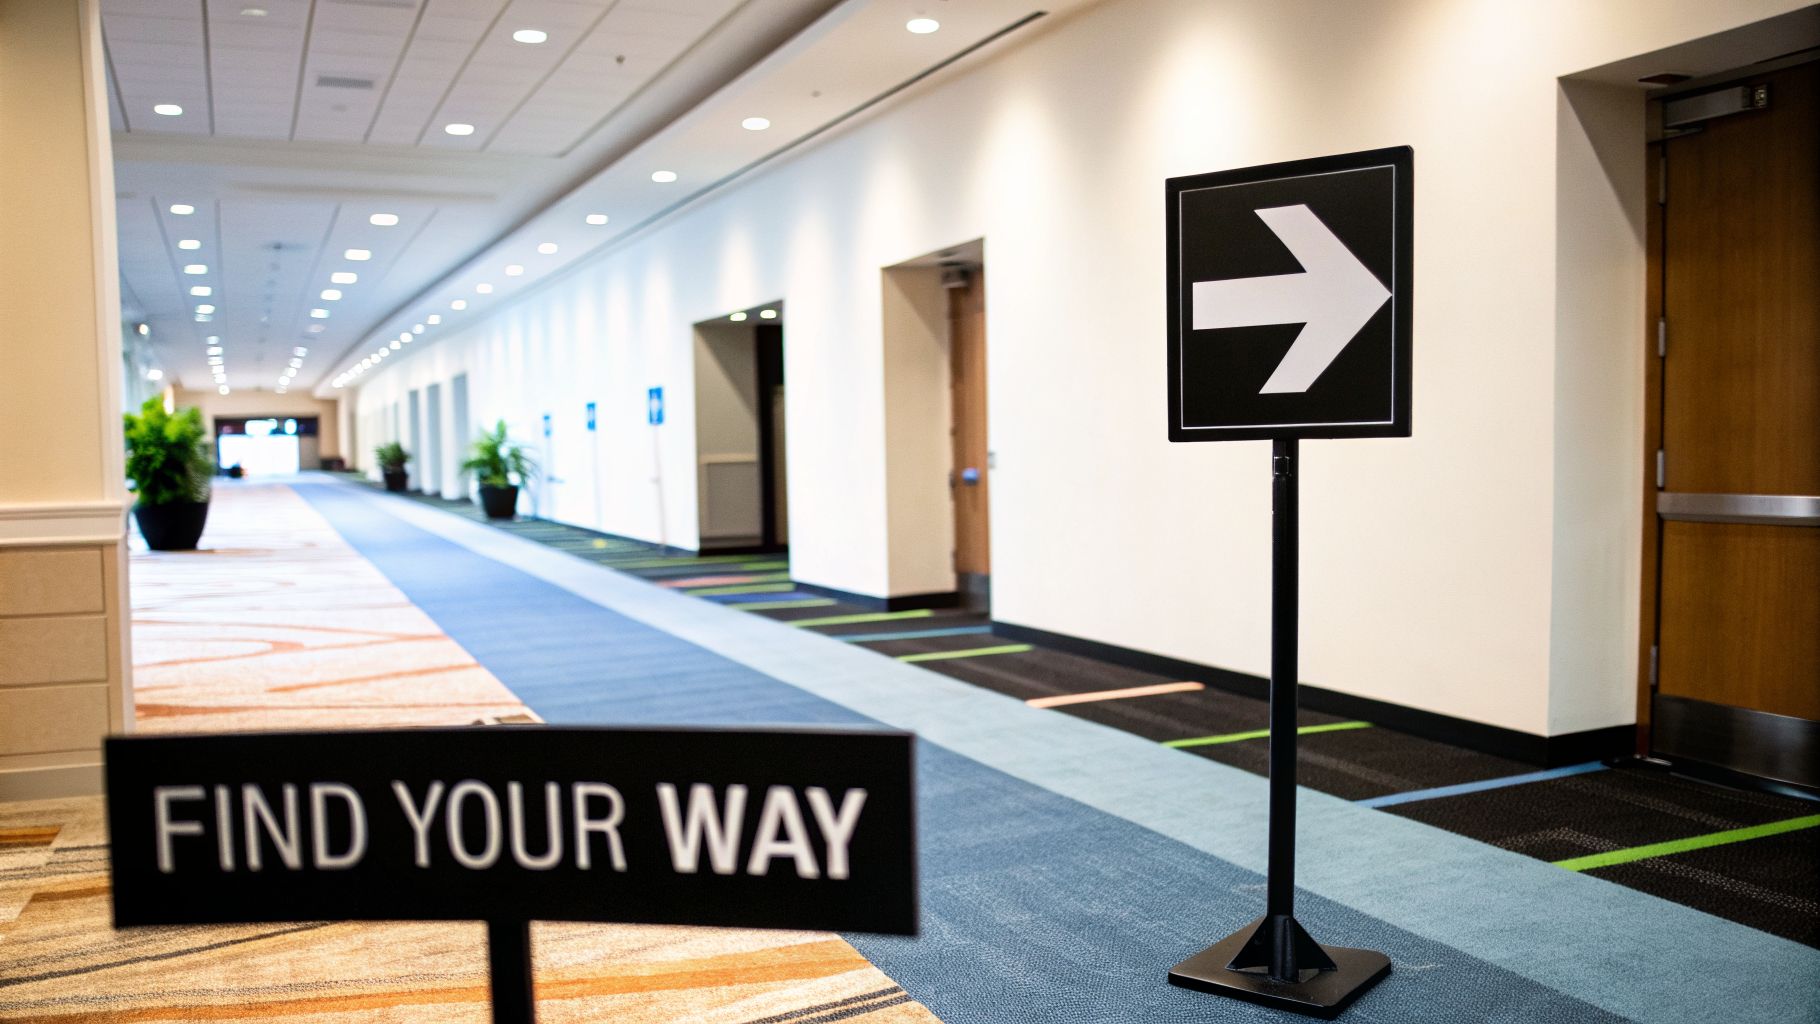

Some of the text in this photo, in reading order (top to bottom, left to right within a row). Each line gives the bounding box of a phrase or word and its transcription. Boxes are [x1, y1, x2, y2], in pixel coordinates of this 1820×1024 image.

[154, 780, 868, 880] FIND YOUR WAY
